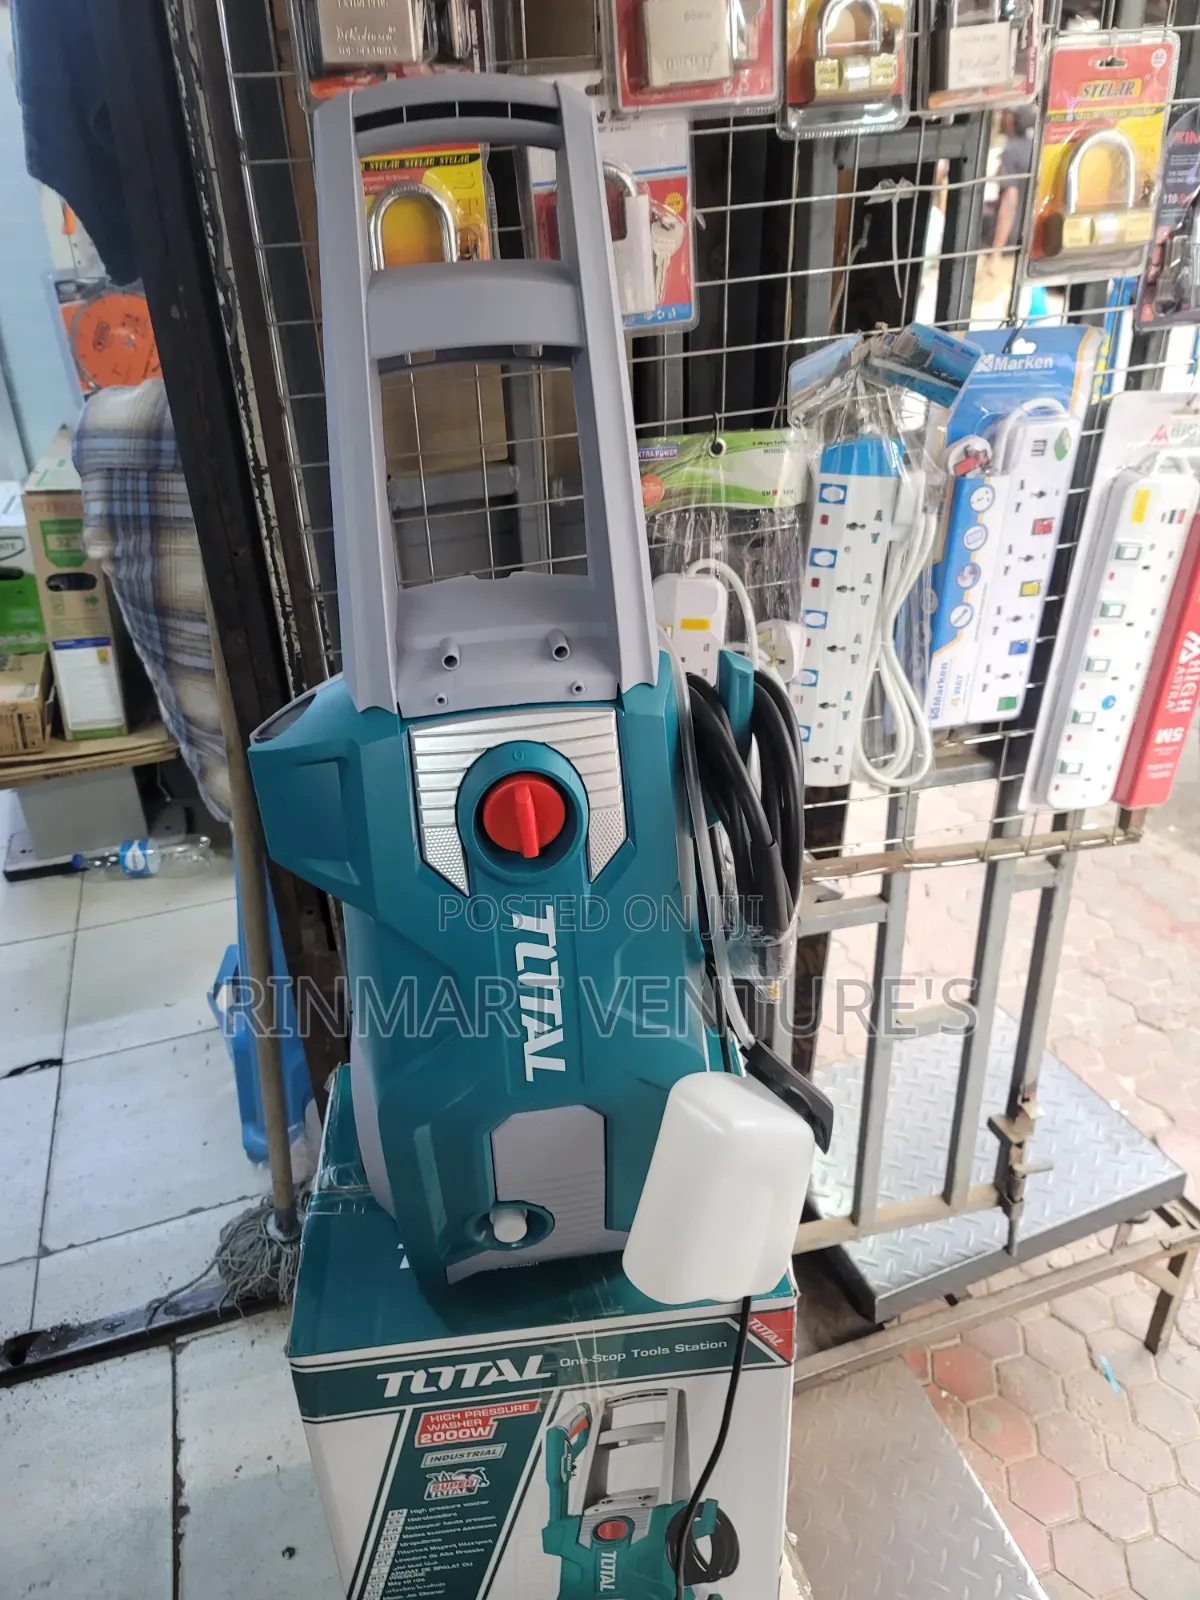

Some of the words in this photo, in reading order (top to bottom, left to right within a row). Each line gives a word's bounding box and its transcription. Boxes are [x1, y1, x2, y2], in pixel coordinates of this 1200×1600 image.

[1082, 80, 1136, 98] STELAR
[994, 355, 1054, 371] Marken
[511, 905, 566, 1083] TOTAL
[748, 1317, 784, 1347] TOTAL
[376, 1354, 556, 1399] TOTAL
[560, 1351, 626, 1368] One-Stop
[631, 1345, 670, 1359] Tools
[674, 1339, 728, 1352] Station
[430, 1410, 461, 1423] HIGH
[464, 1402, 530, 1419] PRESSURE
[426, 1418, 483, 1432] WASHER
[420, 1426, 491, 1444] 2000W
[430, 1448, 499, 1463] INDUSTRIAL
[430, 1479, 477, 1492] SUPER
[410, 1506, 427, 1515] High
[429, 1503, 462, 1512] pressure
[600, 1550, 617, 1592] TOTAL
